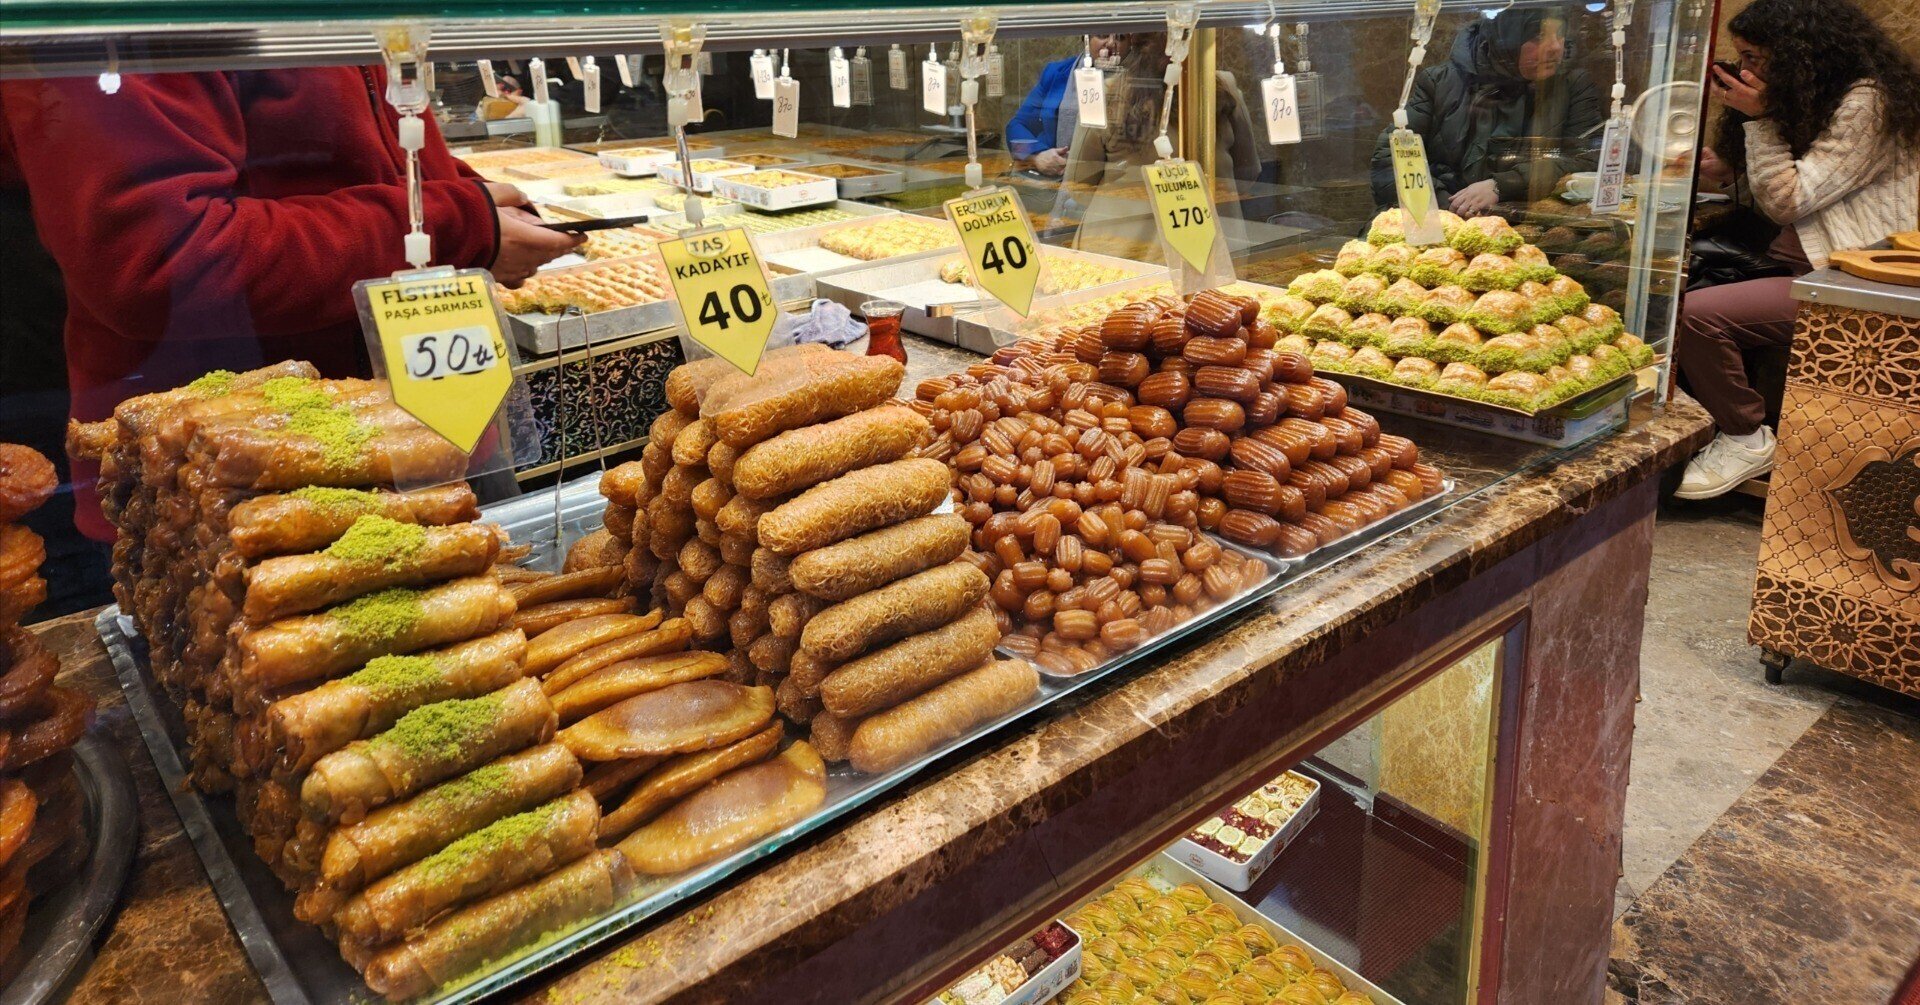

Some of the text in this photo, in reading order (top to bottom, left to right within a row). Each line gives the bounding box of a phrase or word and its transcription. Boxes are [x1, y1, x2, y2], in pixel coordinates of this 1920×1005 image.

[777, 96, 792, 113] 870
[1080, 87, 1100, 104] 980
[1271, 97, 1292, 122] 870
[1155, 179, 1200, 194] TULUMBA
[963, 210, 1017, 232] DOLMASI
[675, 252, 750, 280] KADAYIF
[382, 281, 478, 305] FISTIKLI
[384, 299, 484, 320] PAŞA SARMASI
